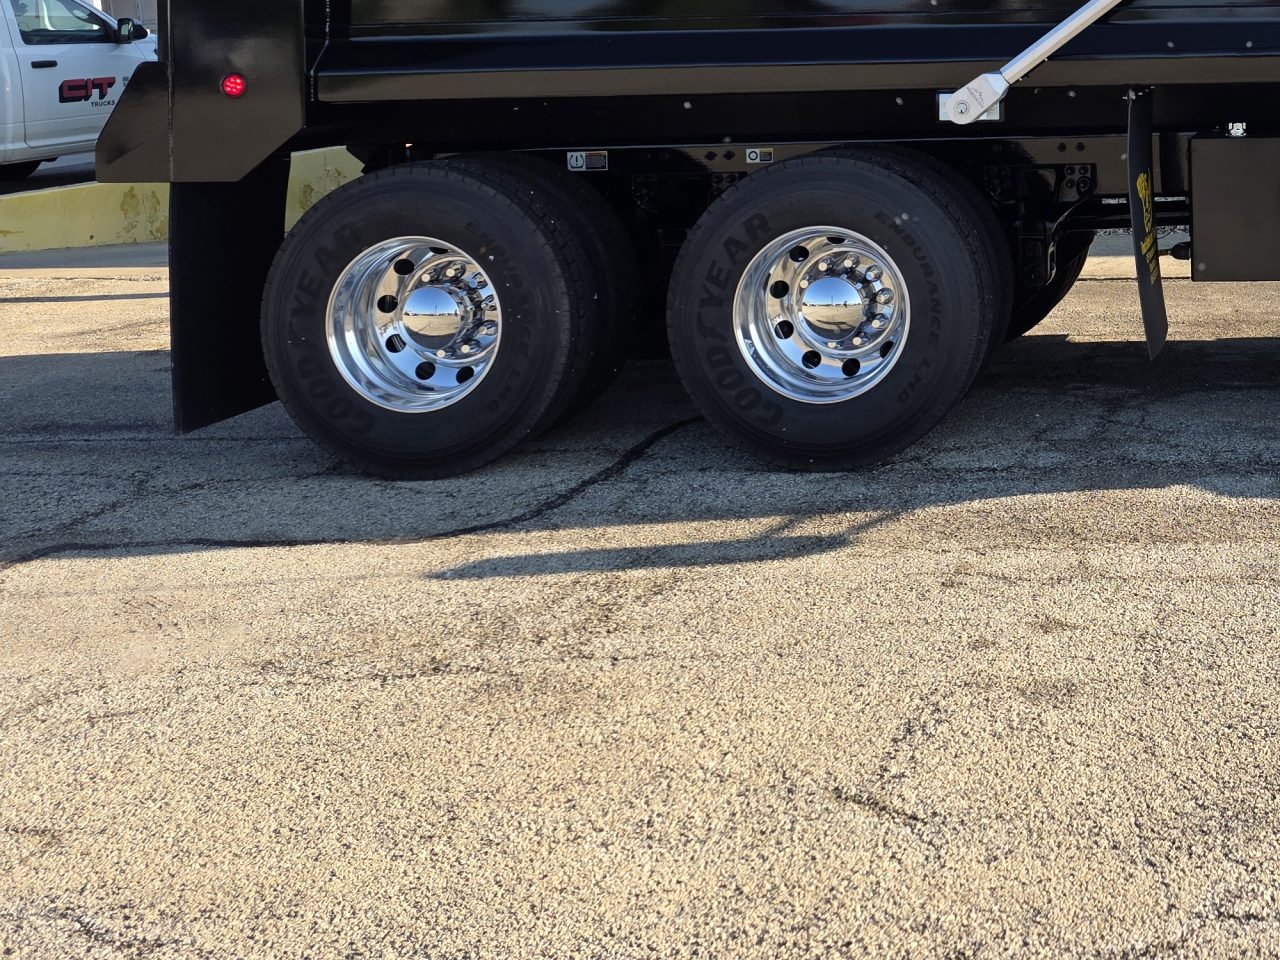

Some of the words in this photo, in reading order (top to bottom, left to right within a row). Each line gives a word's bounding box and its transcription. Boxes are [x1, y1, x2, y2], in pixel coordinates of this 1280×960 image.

[59, 76, 116, 103] CIT
[90, 100, 116, 108] TRUCKS
[288, 222, 375, 436] GOODYEAR
[697, 212, 784, 426] GOODYEAR
[873, 210, 941, 349] ENDURANCE
